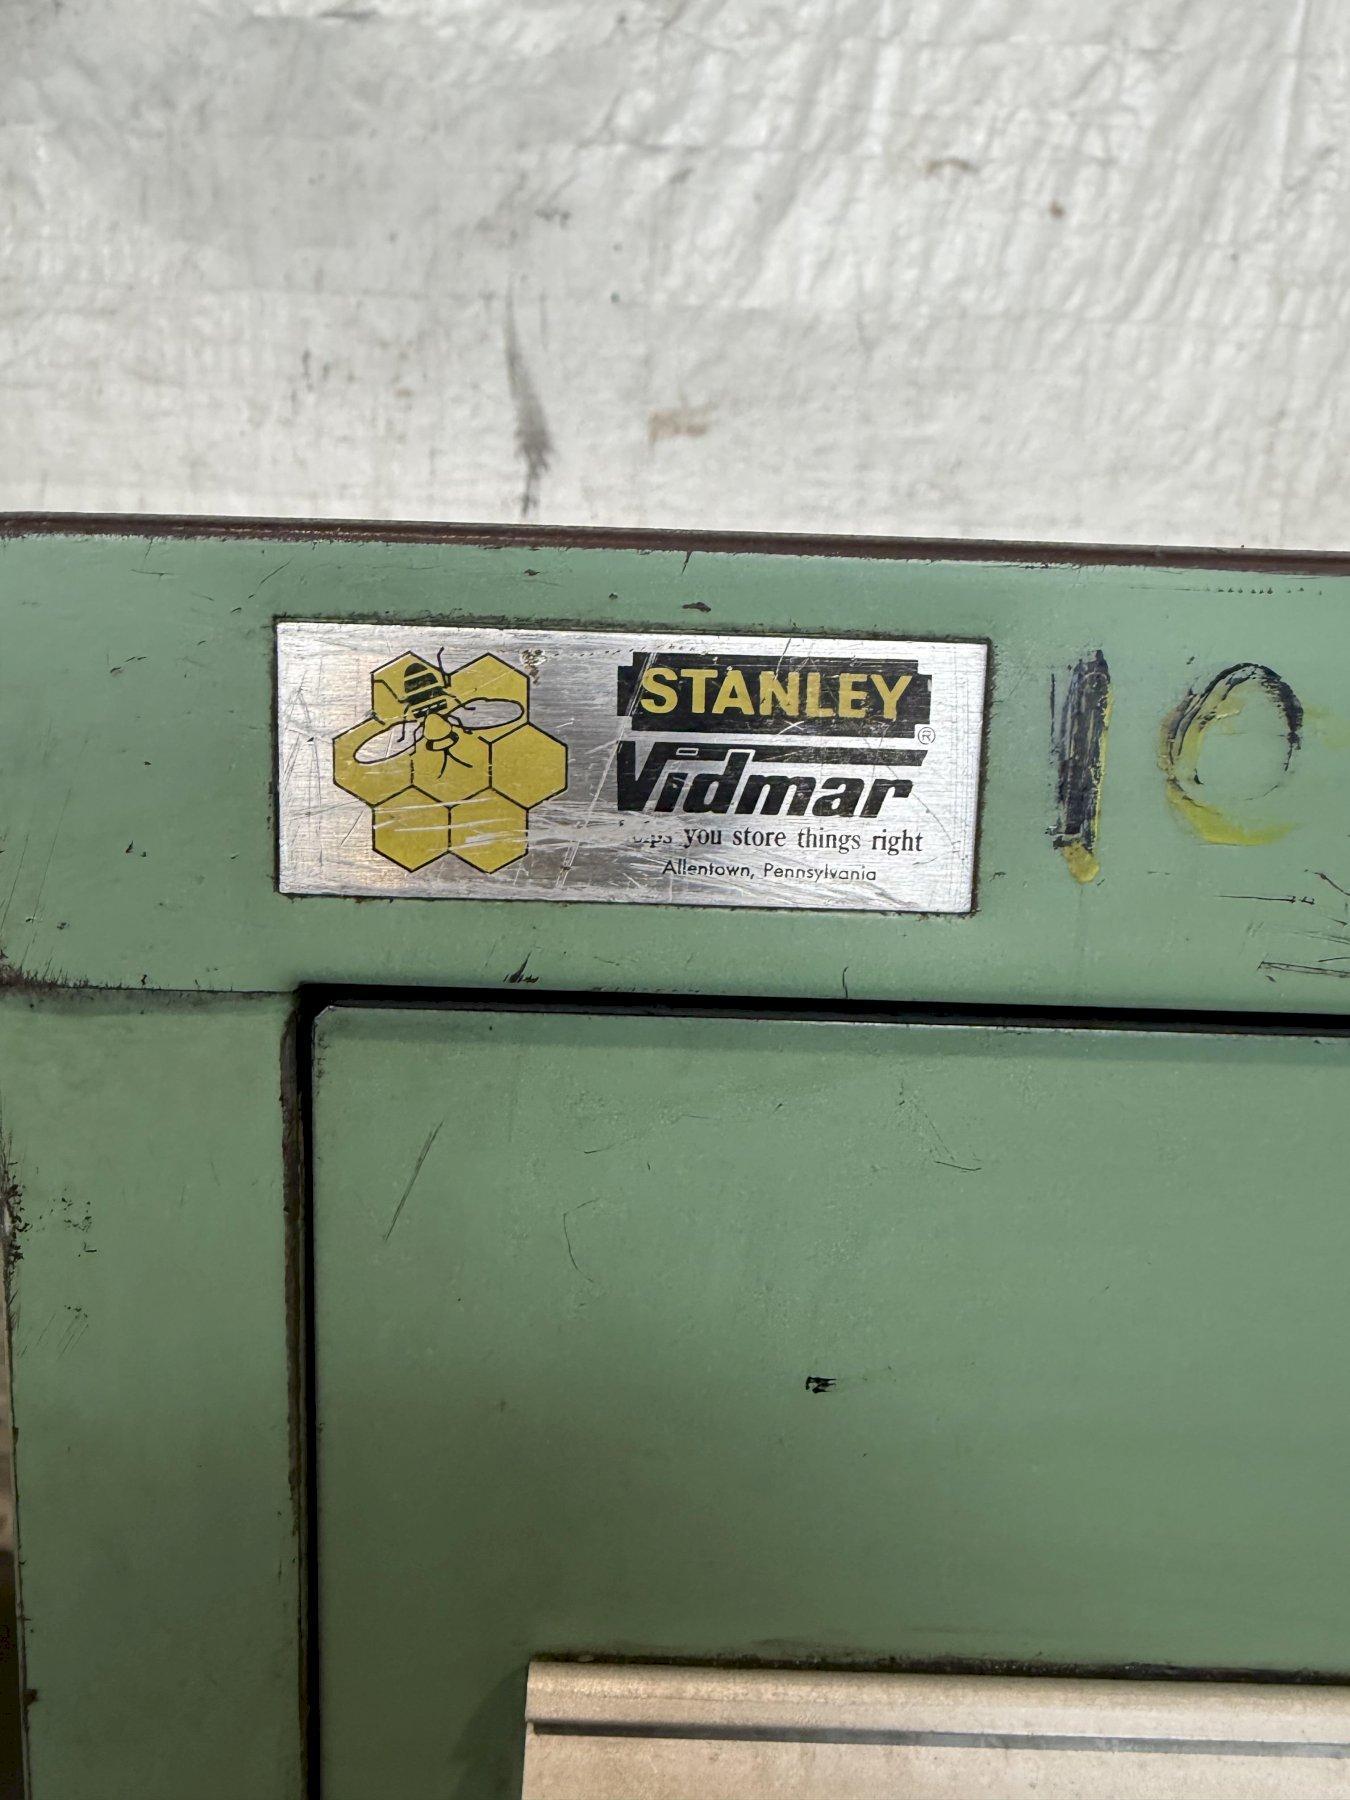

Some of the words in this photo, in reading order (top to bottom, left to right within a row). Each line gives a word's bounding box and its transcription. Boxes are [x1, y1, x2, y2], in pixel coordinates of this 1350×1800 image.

[640, 667, 913, 721] STANLEY
[617, 741, 914, 818] Vidmar
[683, 828, 722, 848] you
[732, 827, 787, 847] store
[797, 827, 861, 854] things
[872, 829, 924, 855] right
[662, 858, 755, 879] Allentown,
[764, 862, 877, 882] Pennsylvania
